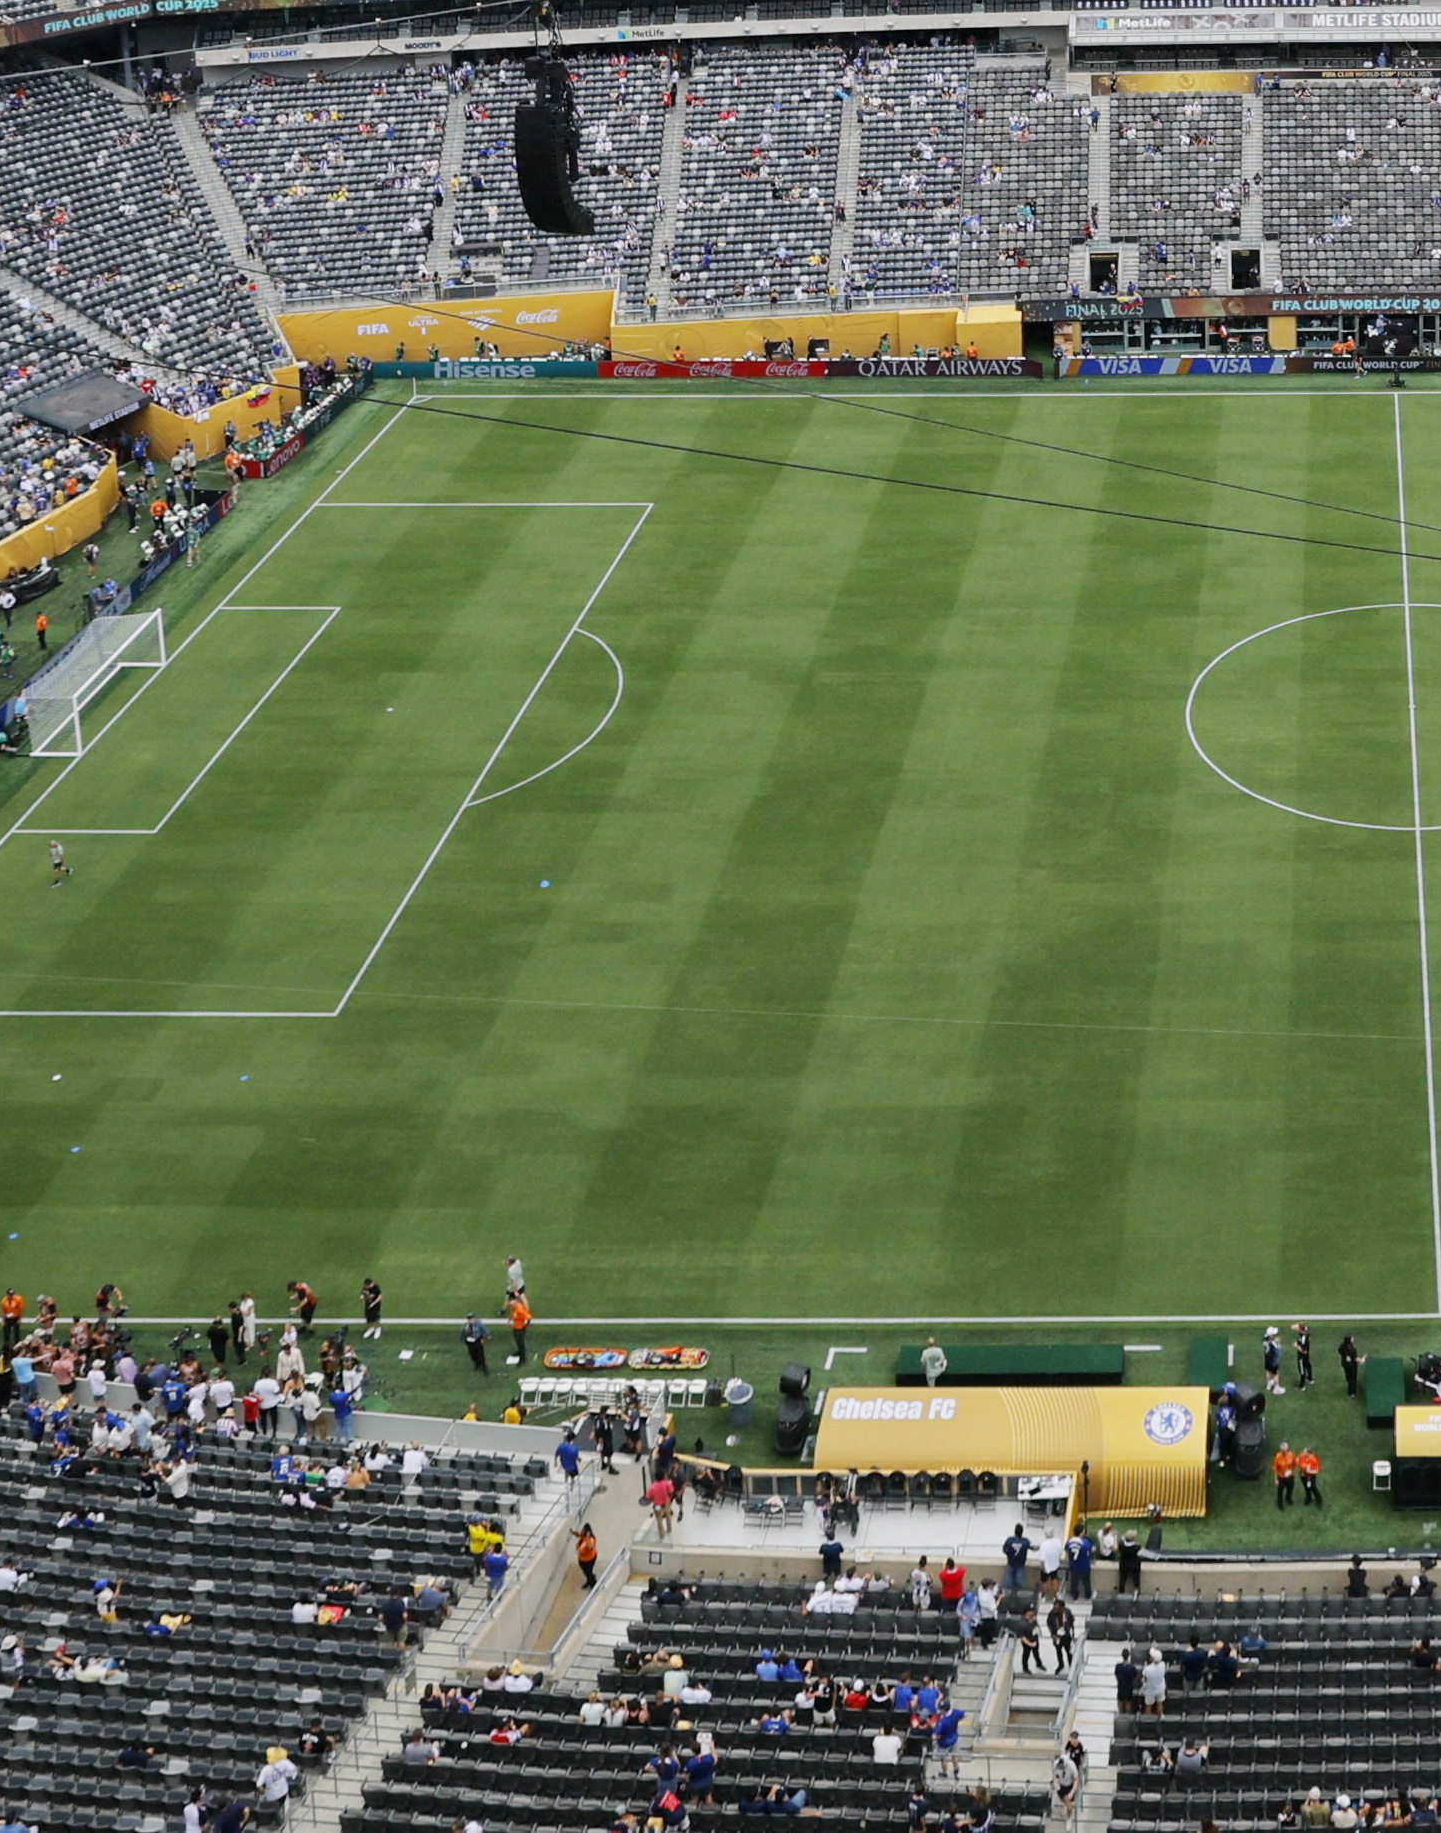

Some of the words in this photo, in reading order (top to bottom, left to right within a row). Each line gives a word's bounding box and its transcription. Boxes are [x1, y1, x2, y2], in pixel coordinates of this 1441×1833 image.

[44, 19, 72, 34] FIFA
[73, 12, 104, 29] CLUB
[105, 3, 150, 23] WORLD
[155, 1, 184, 13] CUP
[1118, 18, 1171, 28] MetLife
[1313, 13, 1378, 27] METLIFE
[632, 29, 665, 38] MetLife
[405, 42, 442, 50] MOODY'S
[249, 50, 270, 59] BUD
[270, 49, 298, 58] LIGHT
[1065, 304, 1107, 317] FINAL
[1272, 300, 1301, 311] FIFA
[1303, 299, 1338, 310] CLUB
[1339, 298, 1392, 310] WORLD
[1393, 298, 1421, 309] CUP
[408, 318, 439, 328] ULTRA
[516, 309, 560, 325] Coca-Cola
[356, 323, 389, 335] FIFA
[434, 362, 536, 378] Hisense
[613, 361, 658, 377] Coca-Cola
[689, 361, 734, 377] Coca-Cola
[765, 361, 810, 377] Coca-Cola
[857, 360, 927, 377] QATAR
[936, 360, 1023, 375] AIRWAYS
[1096, 358, 1142, 374] VISA
[1208, 358, 1252, 373] VISA
[1314, 361, 1335, 369] FIFA
[1363, 361, 1398, 369] WORLD
[831, 1398, 924, 1420] Chelsea
[928, 1398, 956, 1420] FC
[1071, 1548, 1080, 1561] 7
